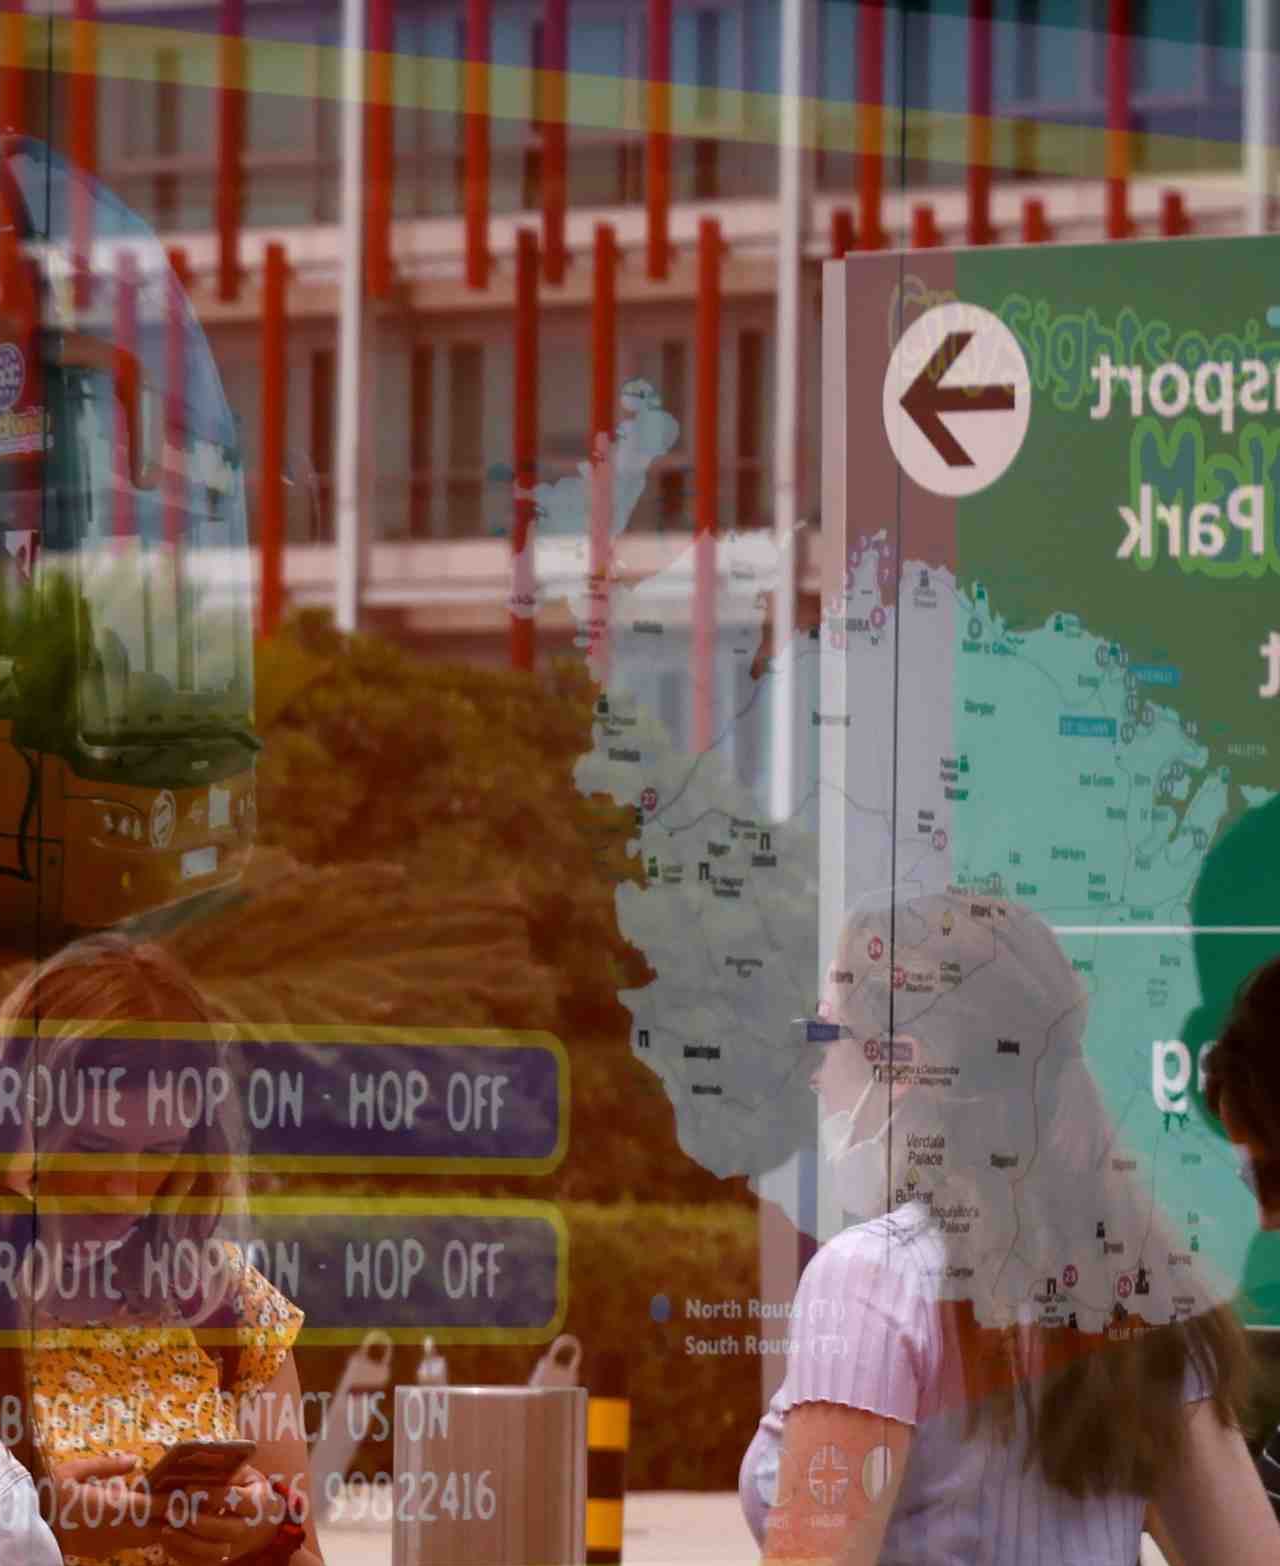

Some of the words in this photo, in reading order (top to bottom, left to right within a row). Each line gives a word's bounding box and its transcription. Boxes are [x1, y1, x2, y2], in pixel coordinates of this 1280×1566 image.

[148, 1065, 230, 1129] HOP
[248, 1068, 305, 1129] ON
[347, 1069, 428, 1132] HOP
[445, 1072, 509, 1133] OFF
[144, 1240, 226, 1302] HOP
[247, 1242, 302, 1301] ON
[345, 1239, 425, 1302] HOP
[443, 1239, 506, 1300] OFF
[684, 1296, 743, 1320] North
[747, 1296, 802, 1320] Route
[683, 1336, 740, 1356] South
[743, 1336, 802, 1356] Route
[193, 1390, 332, 1441] CONTACT
[344, 1390, 391, 1442] US
[402, 1388, 450, 1442] ON
[166, 1486, 210, 1531] or
